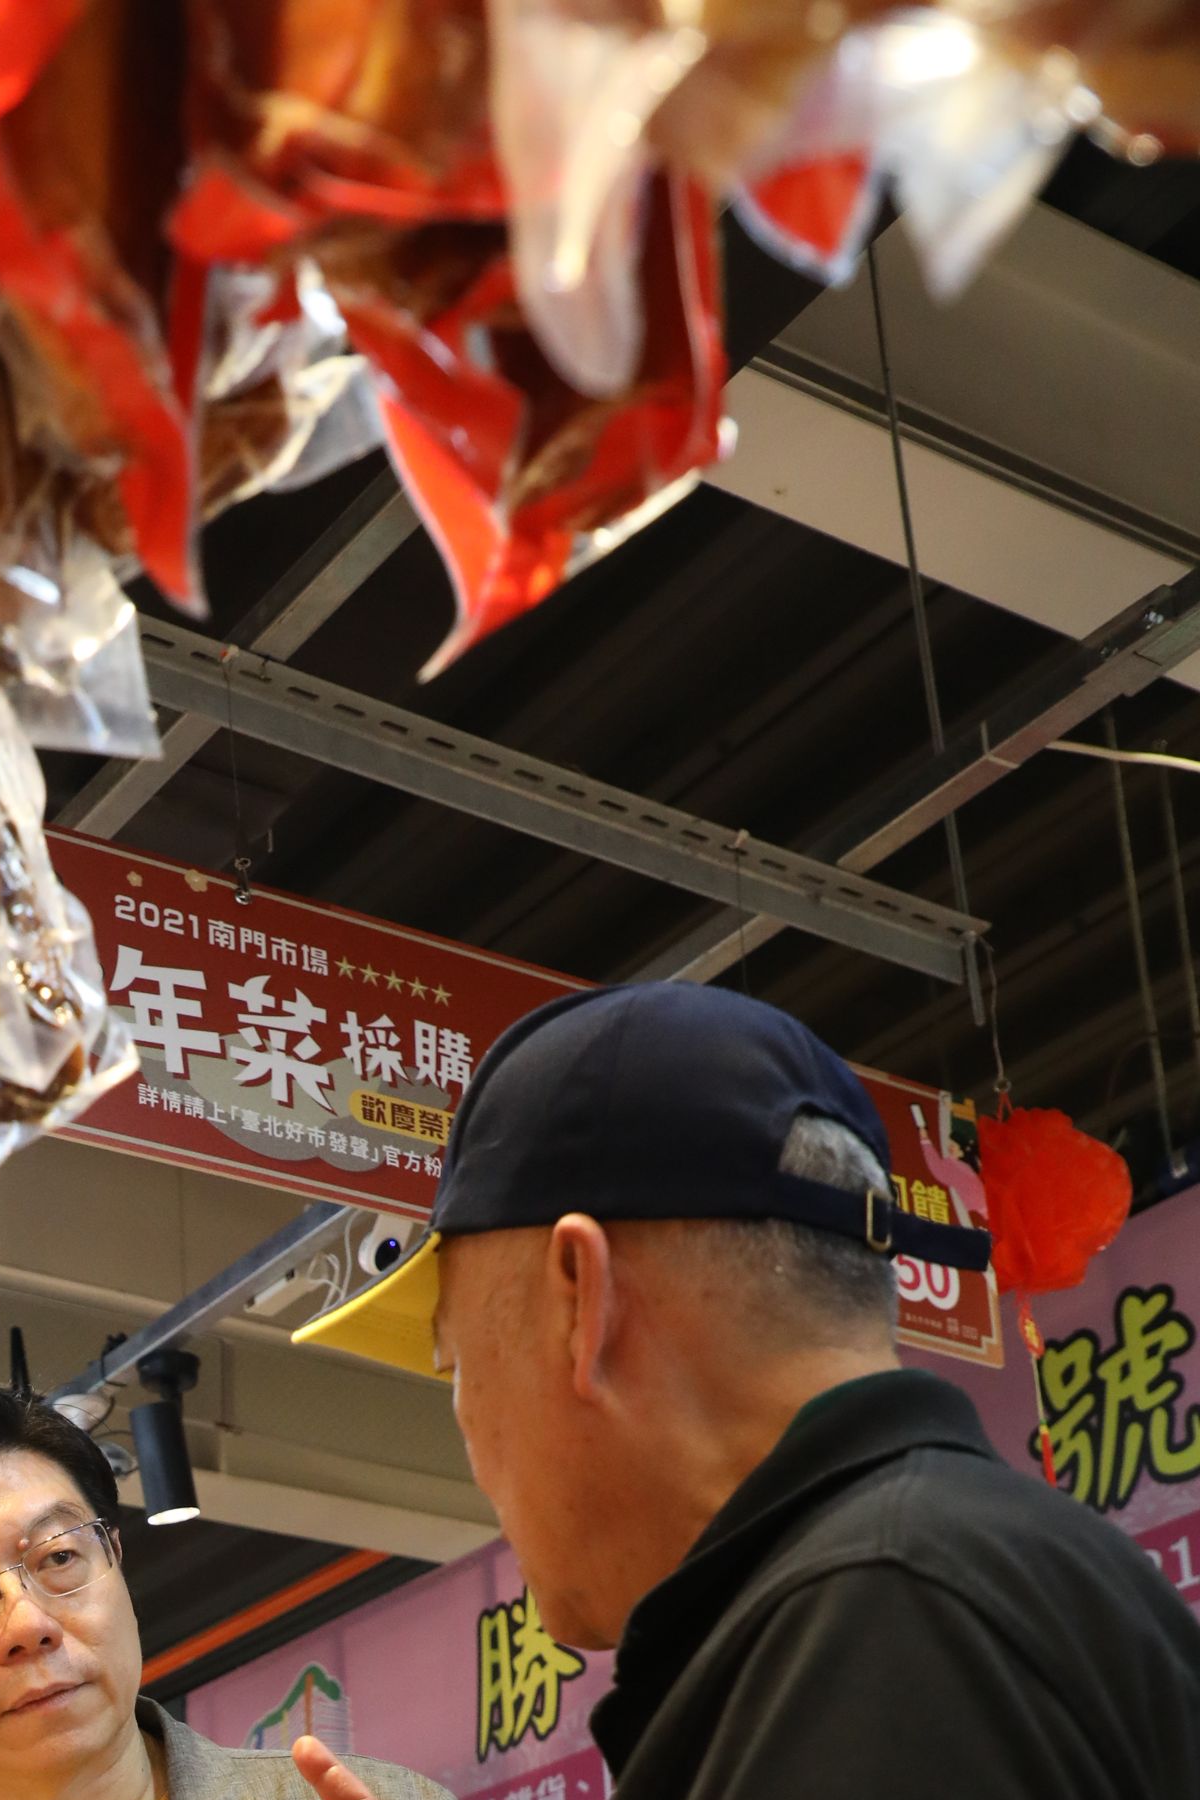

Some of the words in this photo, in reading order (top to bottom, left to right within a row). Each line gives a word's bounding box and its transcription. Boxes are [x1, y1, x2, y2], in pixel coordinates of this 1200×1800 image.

[114, 894, 329, 976] 2021南門市場
[360, 1093, 455, 1140] 歡慶榮
[477, 1584, 585, 1762] 勝
